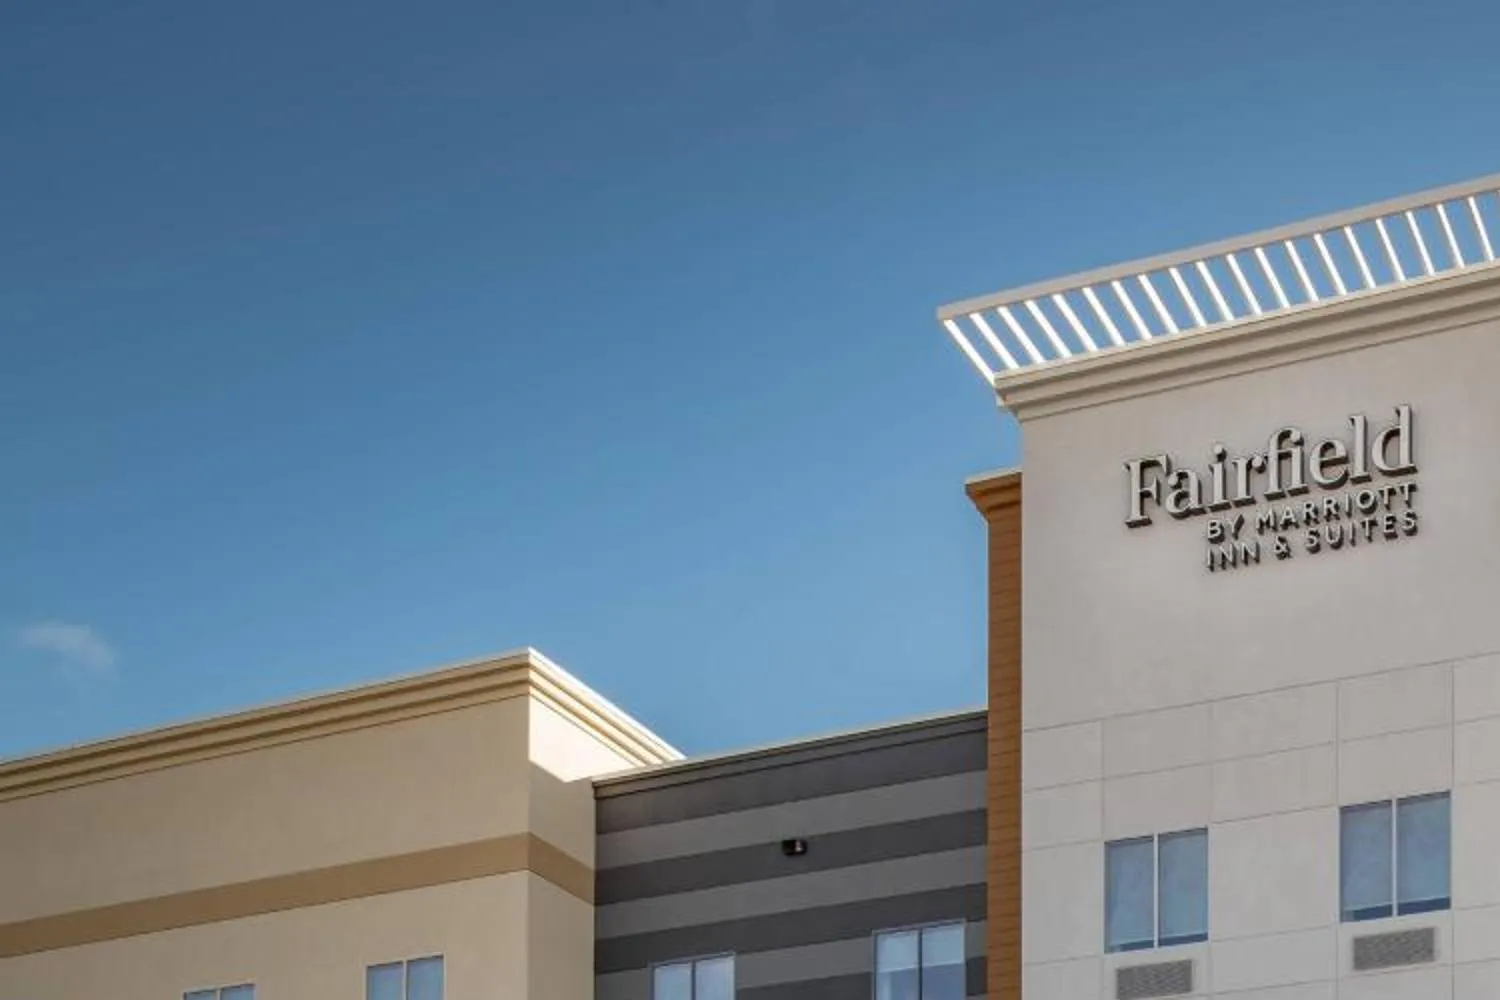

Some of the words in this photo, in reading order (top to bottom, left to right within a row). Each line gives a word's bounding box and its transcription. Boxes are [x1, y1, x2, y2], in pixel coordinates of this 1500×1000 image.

[1122, 403, 1417, 528] Fairfield
[1206, 515, 1244, 543] BY
[1255, 481, 1417, 534] MARRIOTT
[1206, 541, 1260, 573] INN
[1274, 536, 1292, 560] &
[1305, 511, 1418, 553] SUITES
